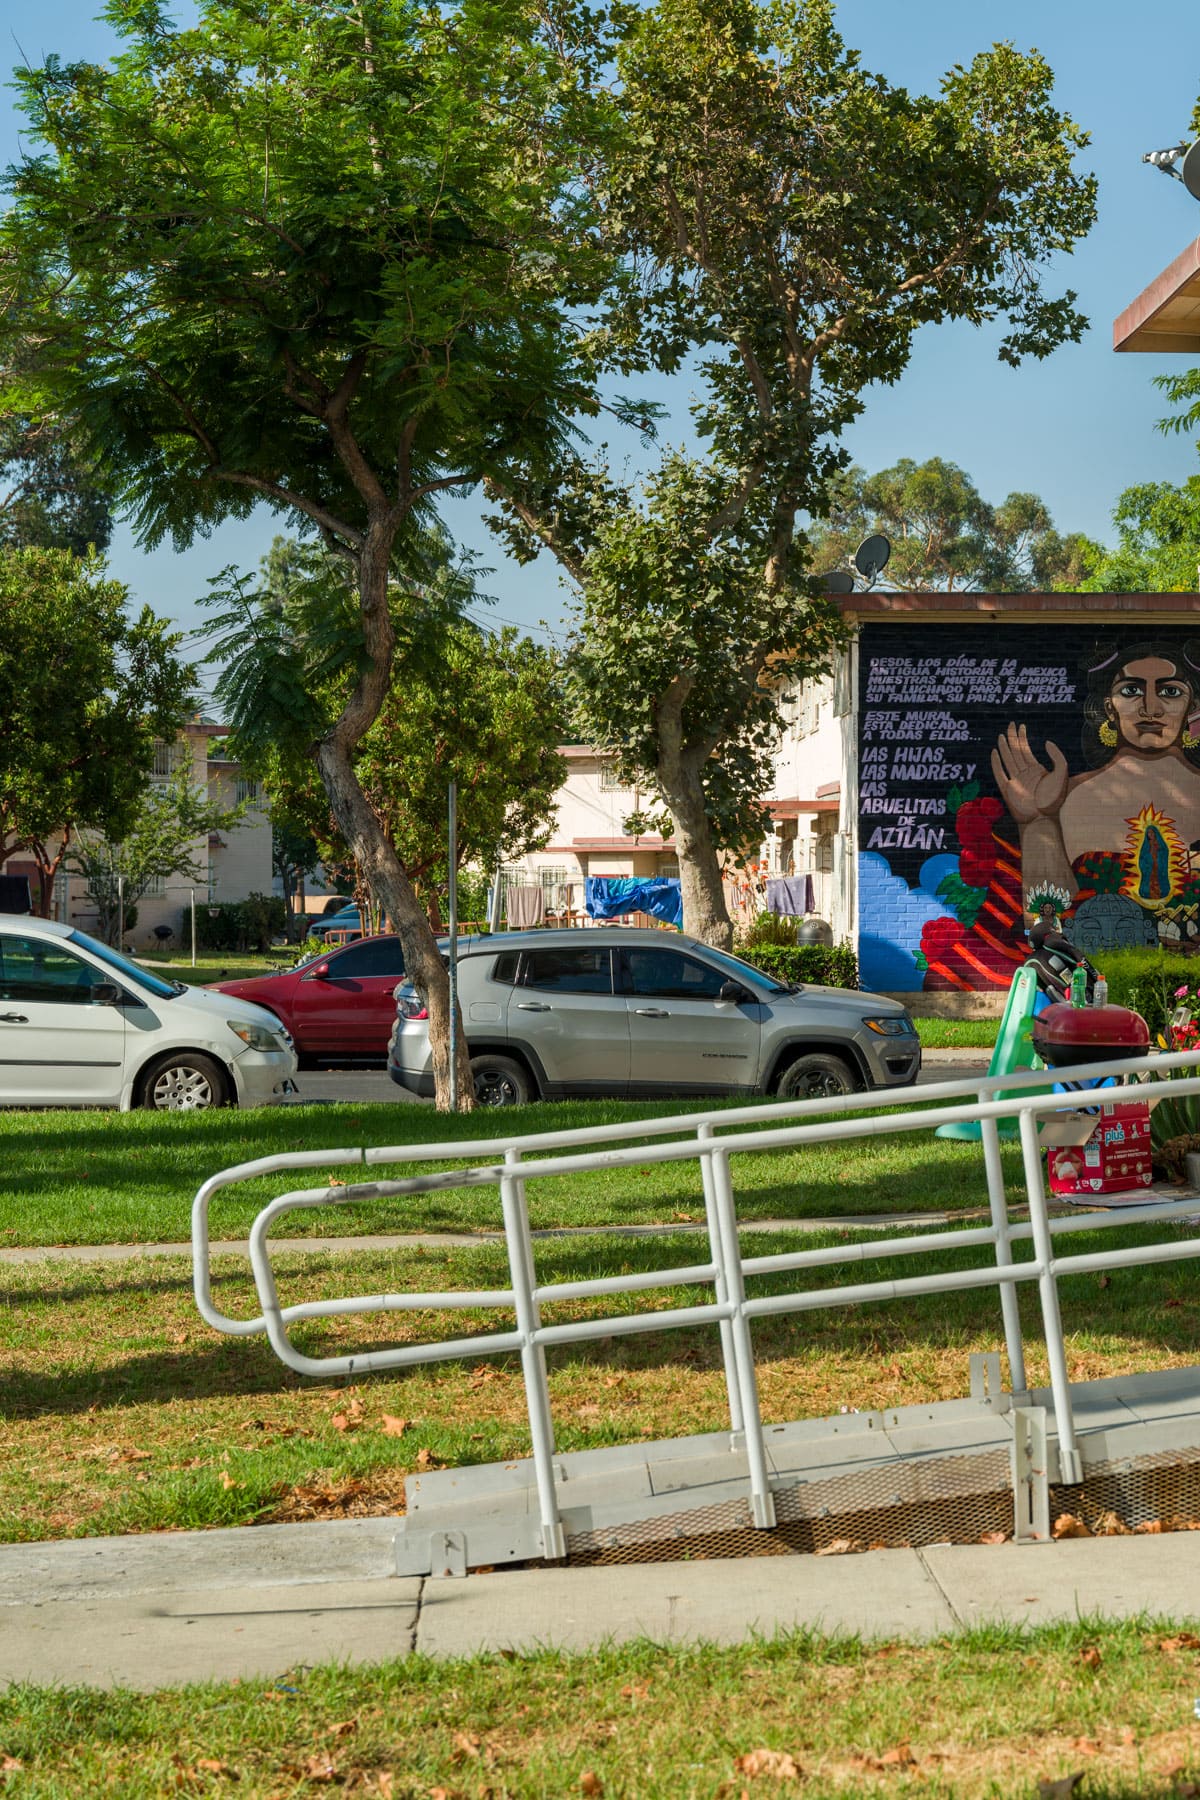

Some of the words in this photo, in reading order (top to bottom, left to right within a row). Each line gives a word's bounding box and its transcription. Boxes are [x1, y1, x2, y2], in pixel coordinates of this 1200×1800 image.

[870, 658, 913, 667] DESDE
[917, 658, 941, 667] LOS
[946, 654, 976, 667] DÍAS
[981, 658, 999, 667] DE
[1002, 658, 1017, 668] LA
[870, 667, 930, 676] ANTIGUA
[935, 667, 993, 676] HISTORIA
[999, 667, 1016, 676] DE
[1020, 667, 1067, 676] MEXICO
[868, 676, 937, 685] NUESTRAS
[943, 676, 1000, 685] MUJERES
[1006, 676, 1068, 685] SIEMPRE
[866, 685, 896, 694] HAN
[901, 685, 963, 695] LUCHADO
[969, 685, 1001, 694] PARA
[1004, 685, 1021, 694] EL
[1026, 685, 1056, 694] BIEN
[1058, 685, 1077, 694] DE
[866, 694, 883, 703] SU
[946, 694, 964, 703] SU
[1015, 694, 1033, 703] SU
[1037, 694, 1076, 703] RAZA.
[865, 711, 901, 721] ESTE
[906, 711, 954, 721] MURAL
[863, 721, 893, 730] ESTA
[899, 720, 968, 730] DEDICADO
[863, 730, 872, 740] A
[879, 730, 923, 740] TODAS
[929, 730, 981, 741] ELLAS...
[861, 747, 888, 762] LAS
[894, 747, 946, 764] HIJAS,
[861, 764, 887, 780] LAS
[860, 782, 887, 797] LAS
[860, 798, 946, 815] ABUELITAS
[897, 816, 917, 826] DE
[867, 823, 947, 850] AZTLÁN.
[1105, 1129, 1125, 1146] plus
